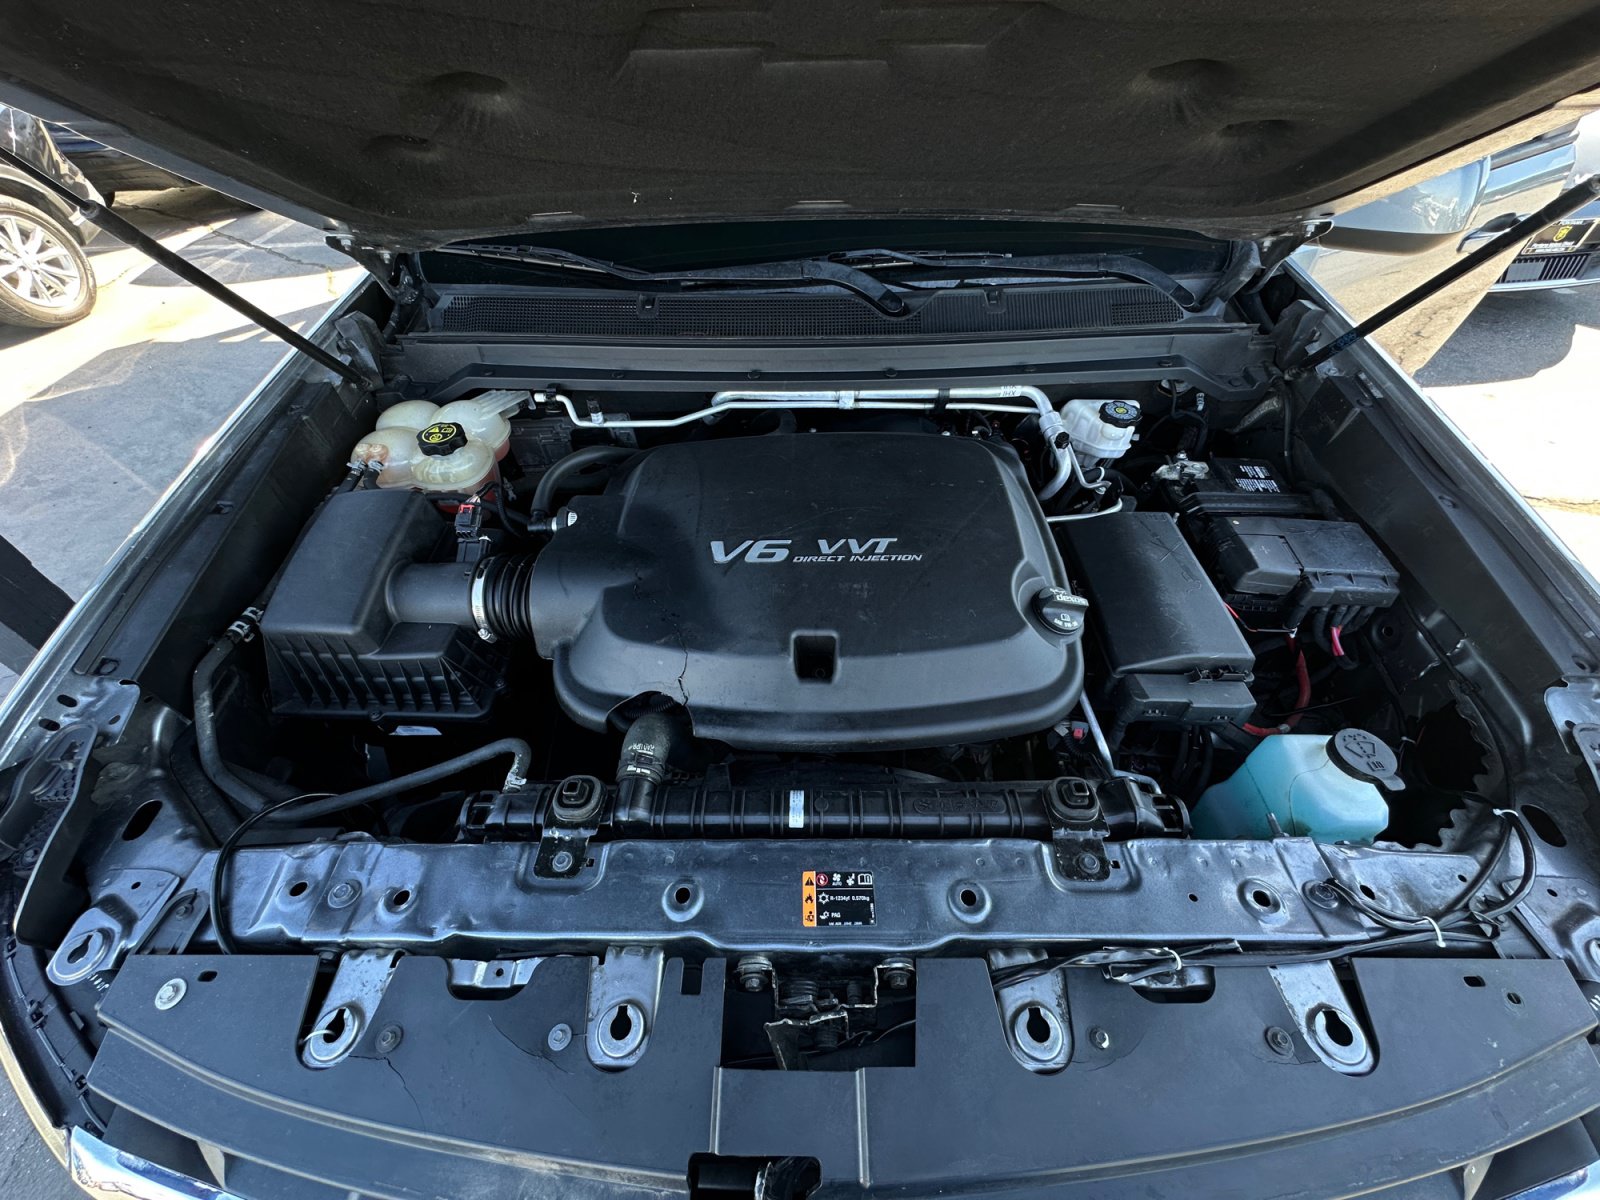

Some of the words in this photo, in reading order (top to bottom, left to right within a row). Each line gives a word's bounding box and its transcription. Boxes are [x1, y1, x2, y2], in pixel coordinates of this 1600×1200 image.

[709, 539, 792, 564] V6
[817, 538, 898, 554] VVT
[792, 555, 846, 563] DIRECT
[849, 554, 923, 562] INJECTION
